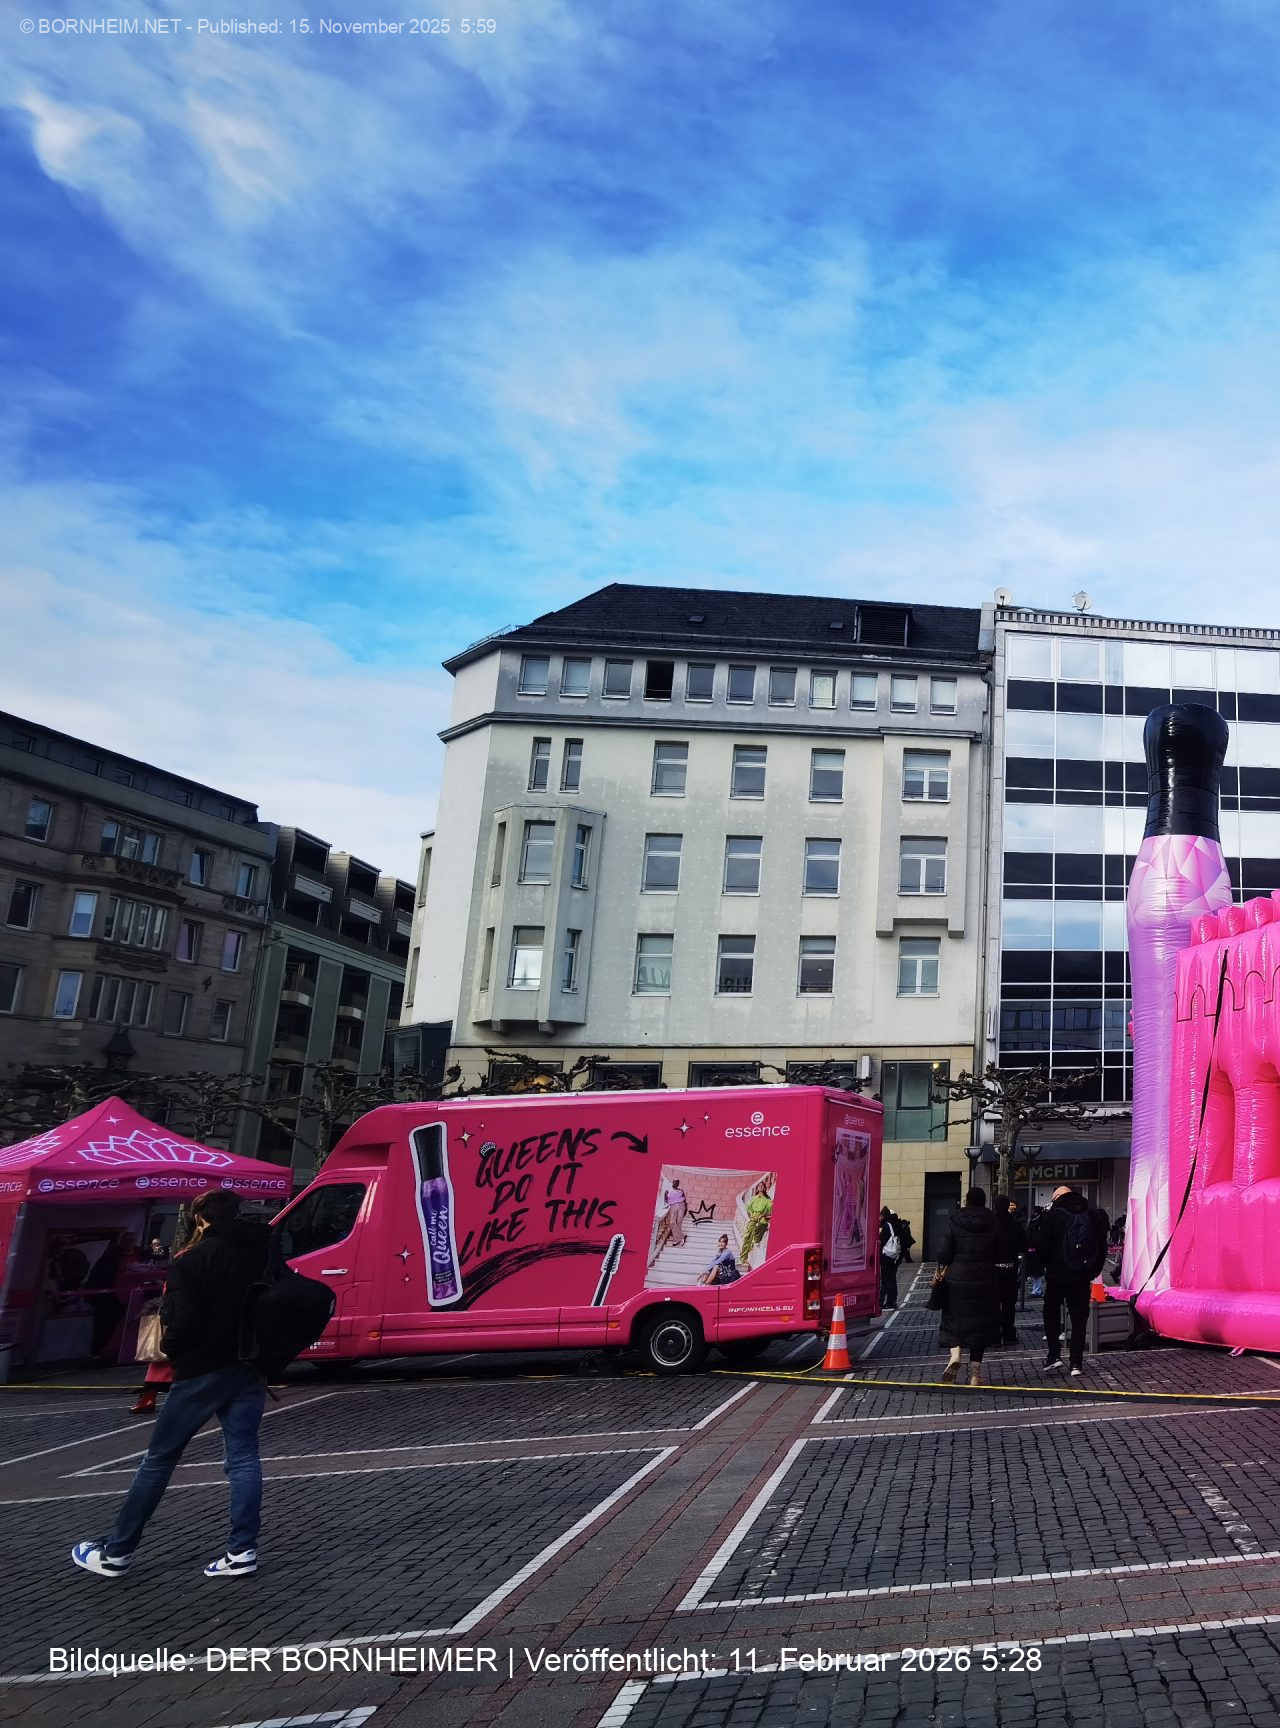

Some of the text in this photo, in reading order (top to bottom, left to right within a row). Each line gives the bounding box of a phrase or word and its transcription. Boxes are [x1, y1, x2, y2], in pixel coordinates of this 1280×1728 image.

[725, 1125, 791, 1138] essence
[475, 1128, 602, 1188] QUEENS
[1031, 1164, 1080, 1178] McFIT
[38, 1179, 120, 1192] essence
[135, 1177, 207, 1189] essence
[221, 1178, 286, 1189] essence
[489, 1162, 583, 1215] DO IT
[432, 1204, 451, 1264] Queen
[459, 1197, 617, 1266] LIKE THIS
[728, 1305, 794, 1313] INFOWHEELS.EU
